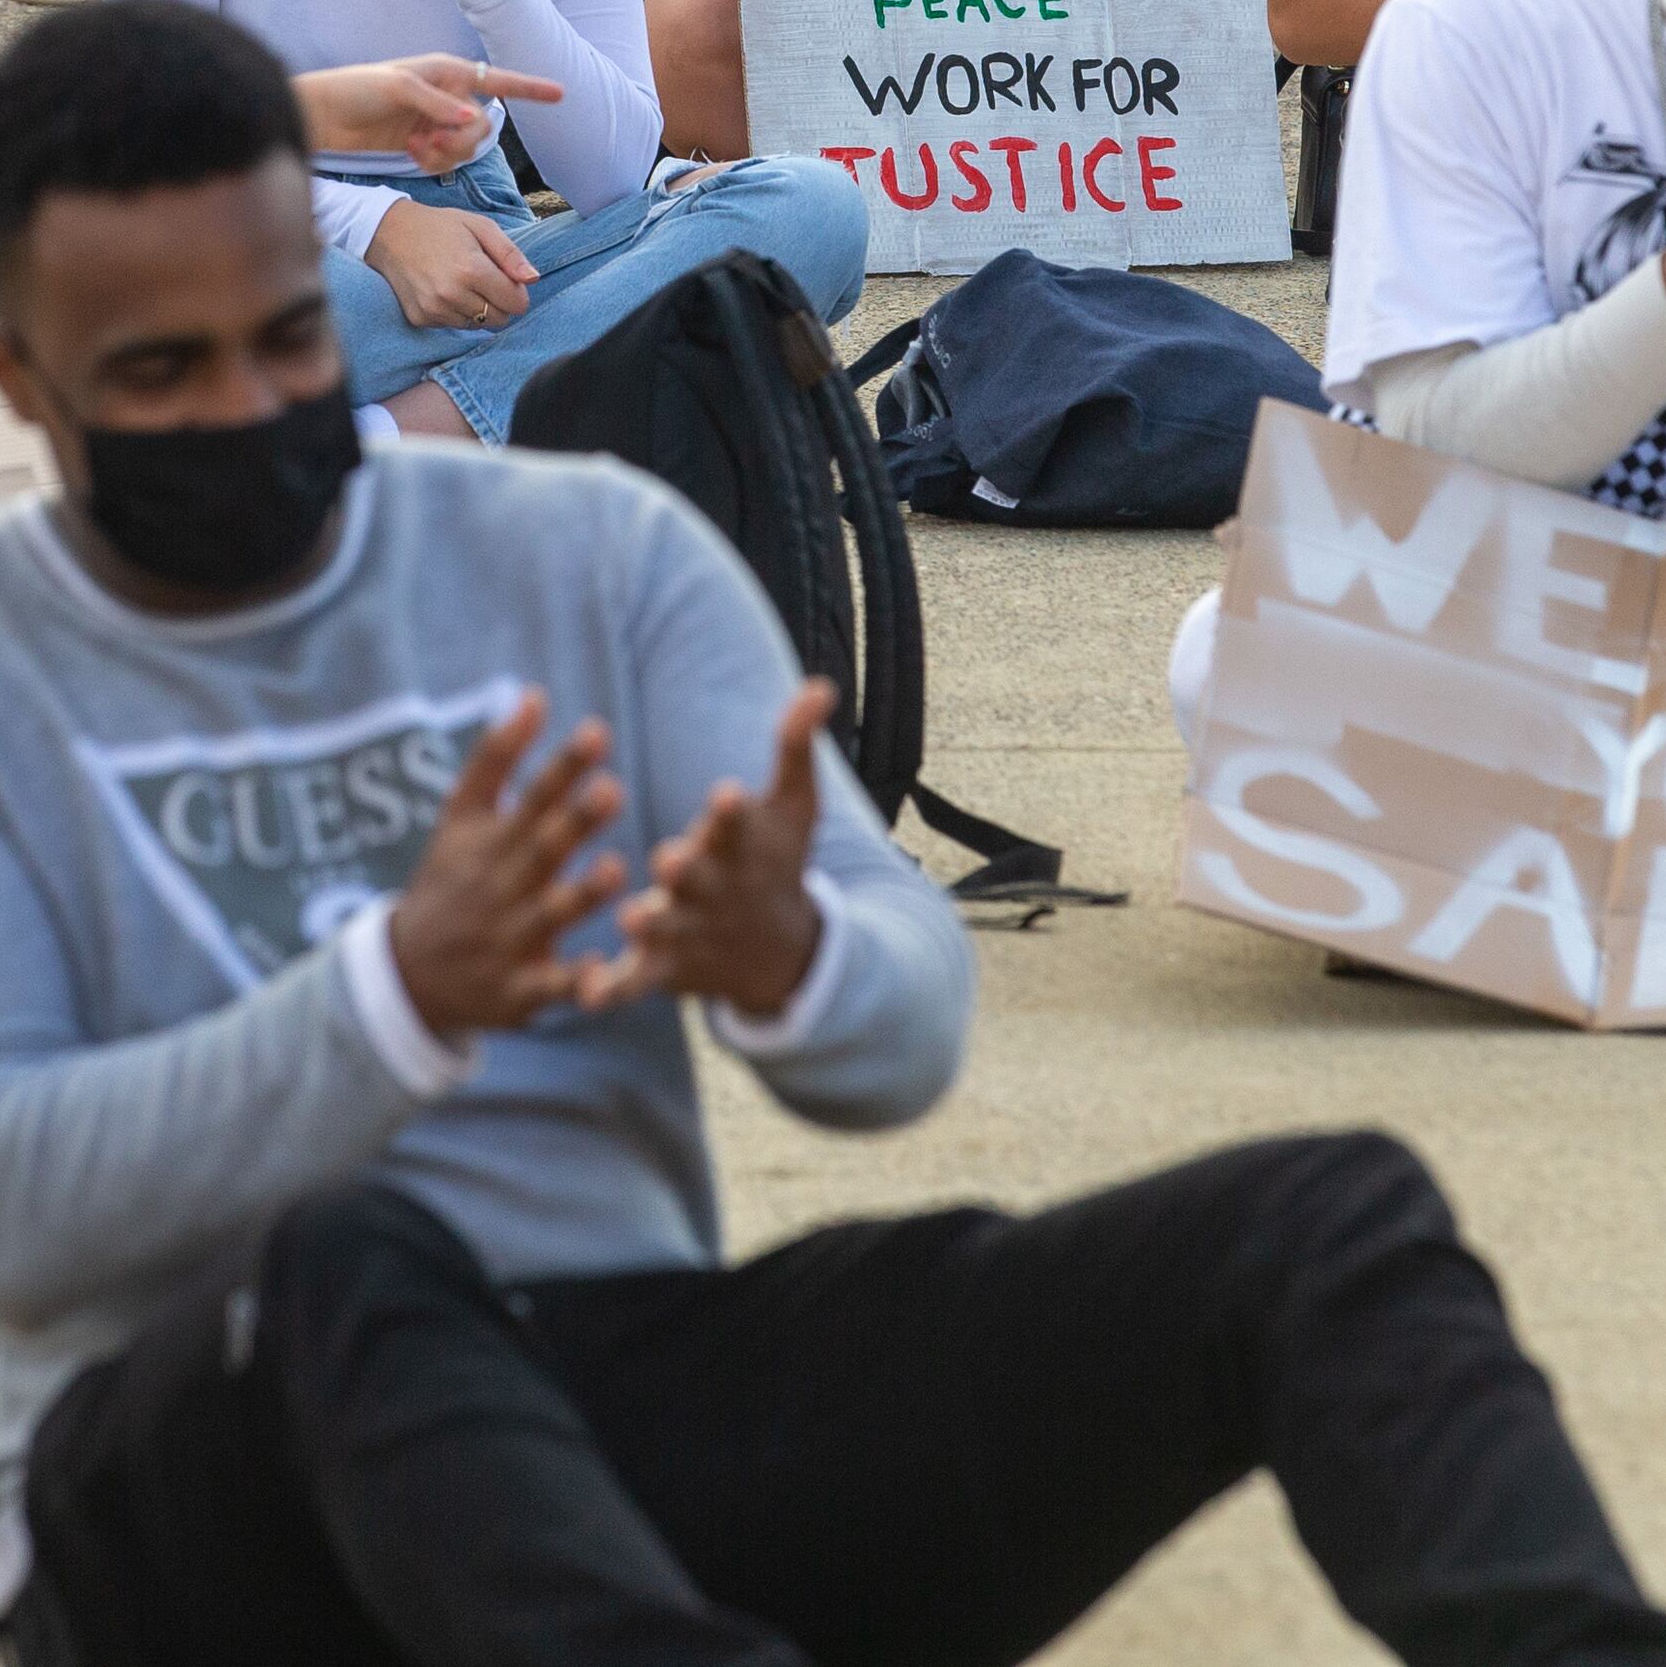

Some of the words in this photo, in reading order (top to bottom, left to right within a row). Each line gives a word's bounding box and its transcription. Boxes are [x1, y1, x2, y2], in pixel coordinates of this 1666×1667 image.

[842, 51, 1057, 116] WORK
[1072, 56, 1182, 116] FOR
[161, 727, 465, 868] GUESS
